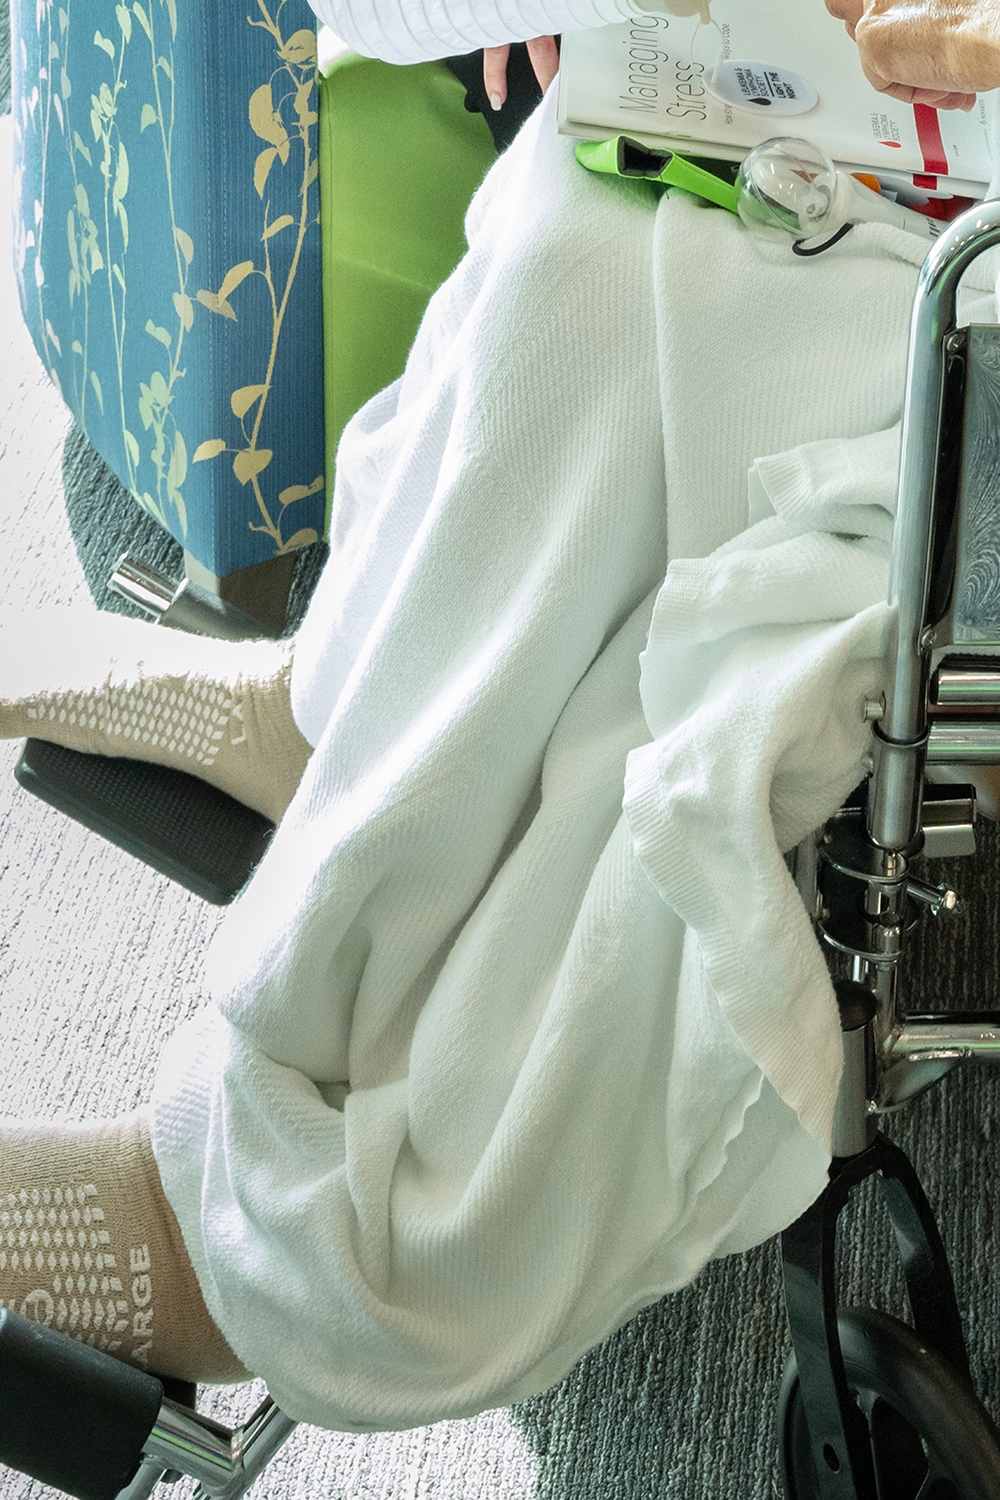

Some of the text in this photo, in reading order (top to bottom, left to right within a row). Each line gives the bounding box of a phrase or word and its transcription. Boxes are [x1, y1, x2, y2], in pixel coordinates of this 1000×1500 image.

[618, 15, 669, 114] Managing
[666, 60, 707, 121] Stress
[736, 72, 751, 95] LEUKEMIA
[744, 69, 760, 97] LYMPHOMA
[768, 71, 787, 98] LIGHT THE
[783, 82, 797, 100] NIGHT
[871, 117, 882, 139] LEUKEMIA
[880, 114, 891, 140] LYMPHOMA
[130, 1244, 154, 1366] ARGE
